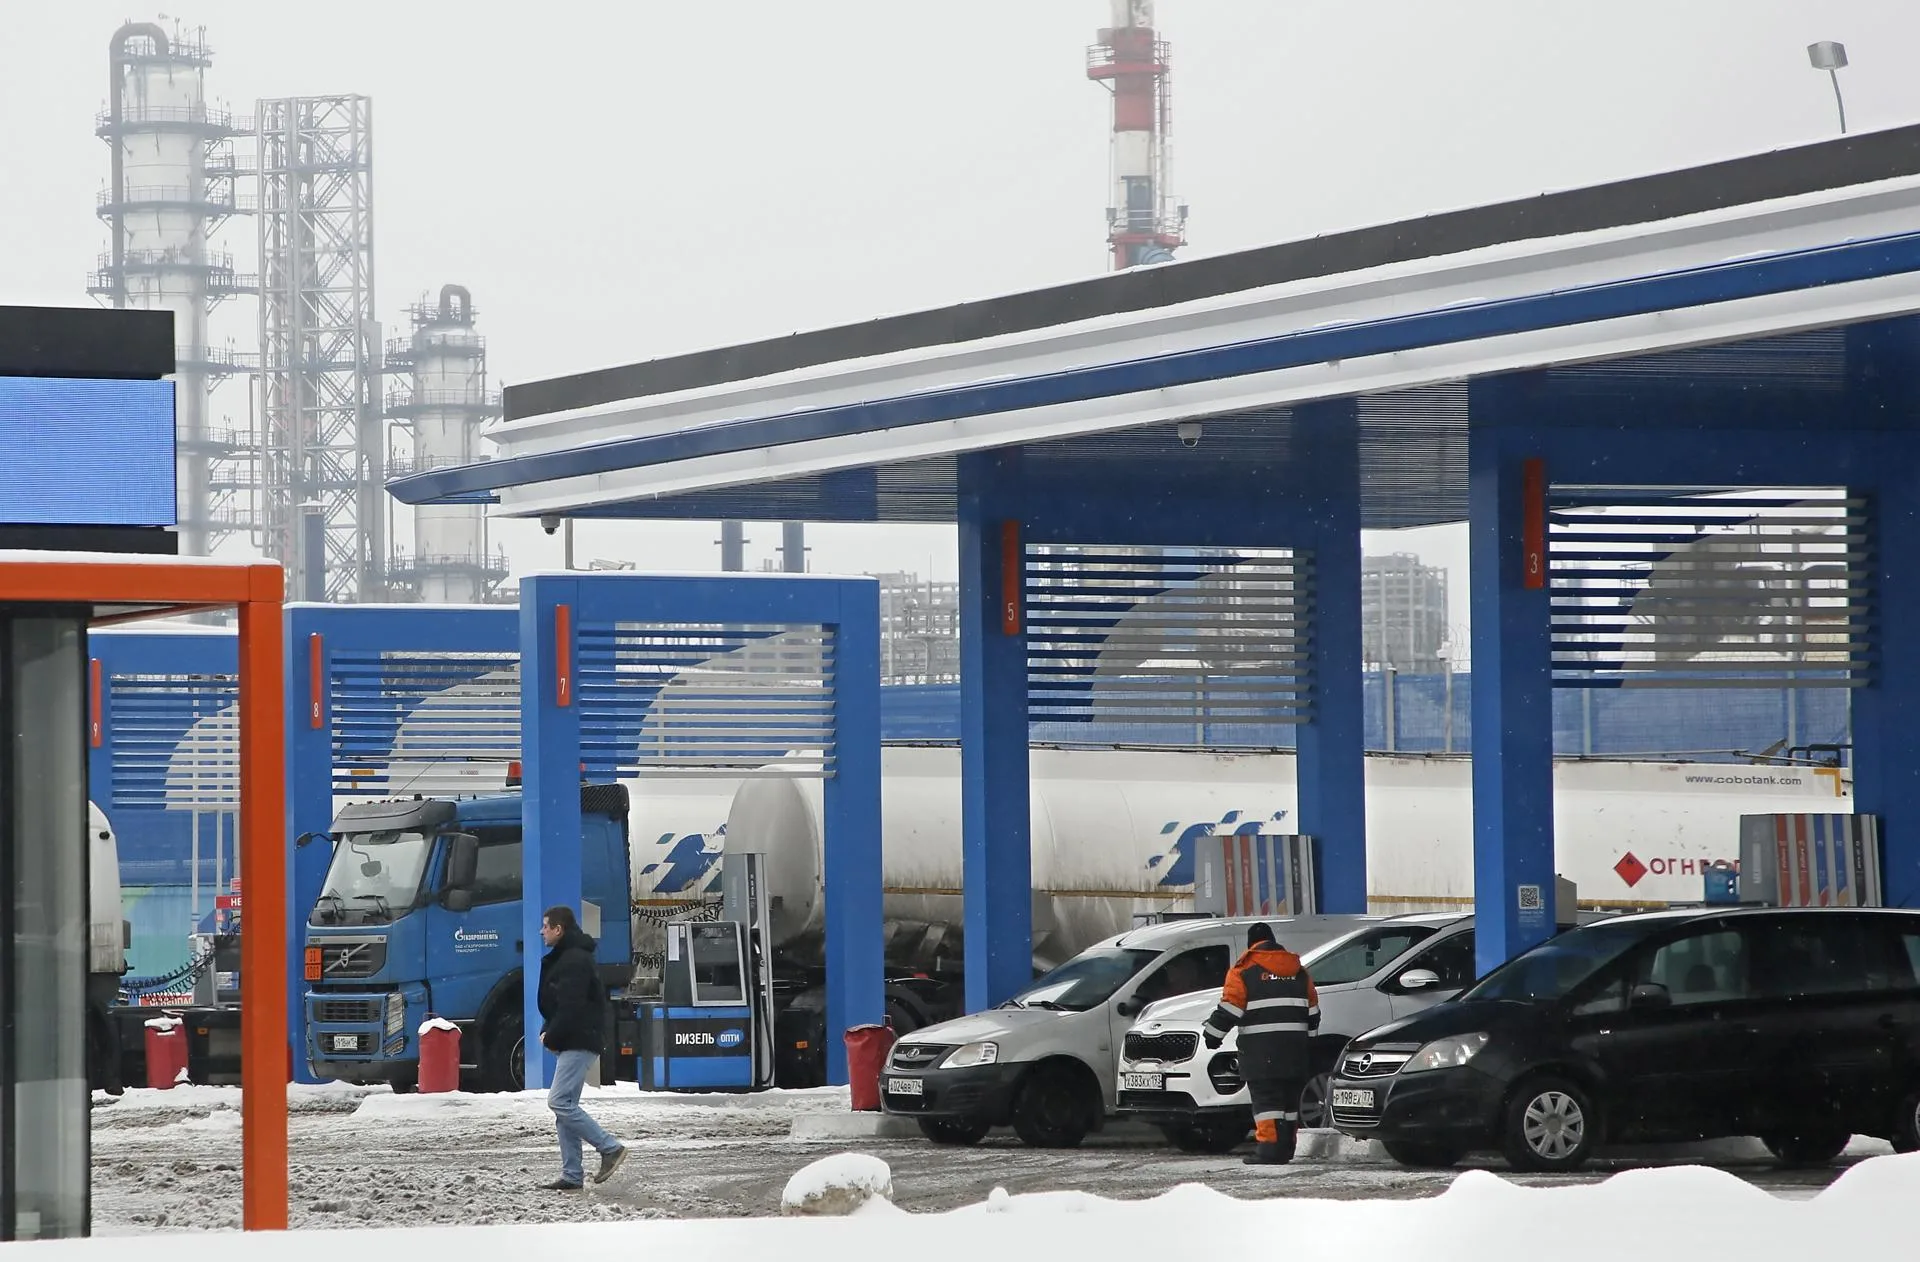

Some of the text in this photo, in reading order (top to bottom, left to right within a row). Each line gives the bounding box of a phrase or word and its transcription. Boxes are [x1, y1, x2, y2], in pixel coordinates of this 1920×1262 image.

[1530, 552, 1538, 574] 3
[1007, 602, 1014, 621] 5
[560, 677, 566, 695] 7
[313, 702, 319, 718] 8
[93, 722, 98, 737] 9
[1685, 776, 1802, 785] www.cobotank.com
